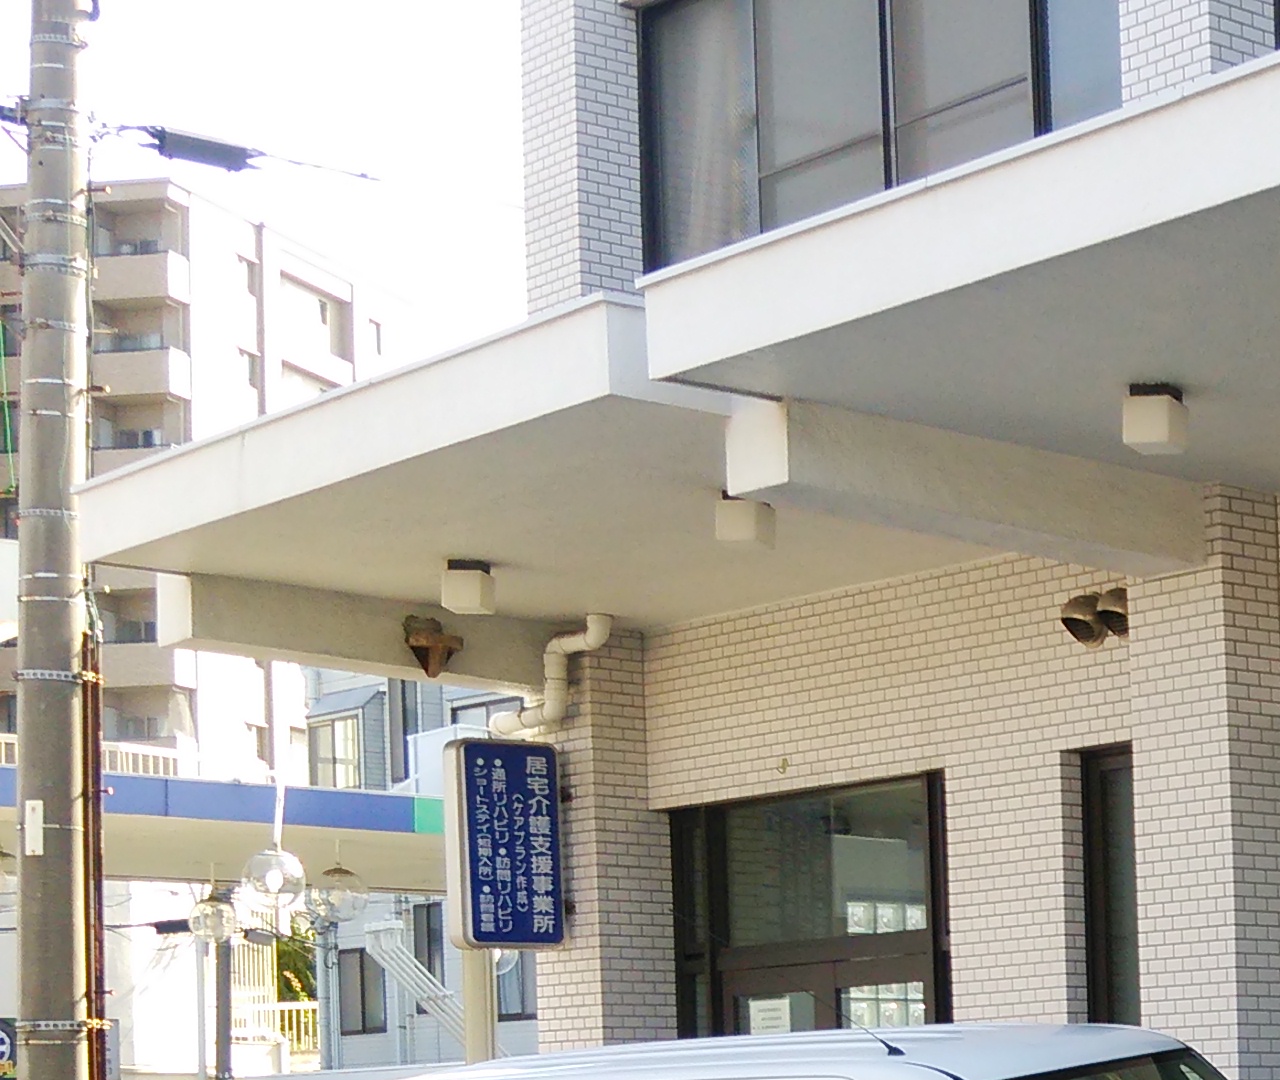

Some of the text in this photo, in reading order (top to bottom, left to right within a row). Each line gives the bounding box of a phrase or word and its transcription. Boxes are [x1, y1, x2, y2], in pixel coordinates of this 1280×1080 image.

[526, 756, 555, 934] 居宅介護支援事業所
